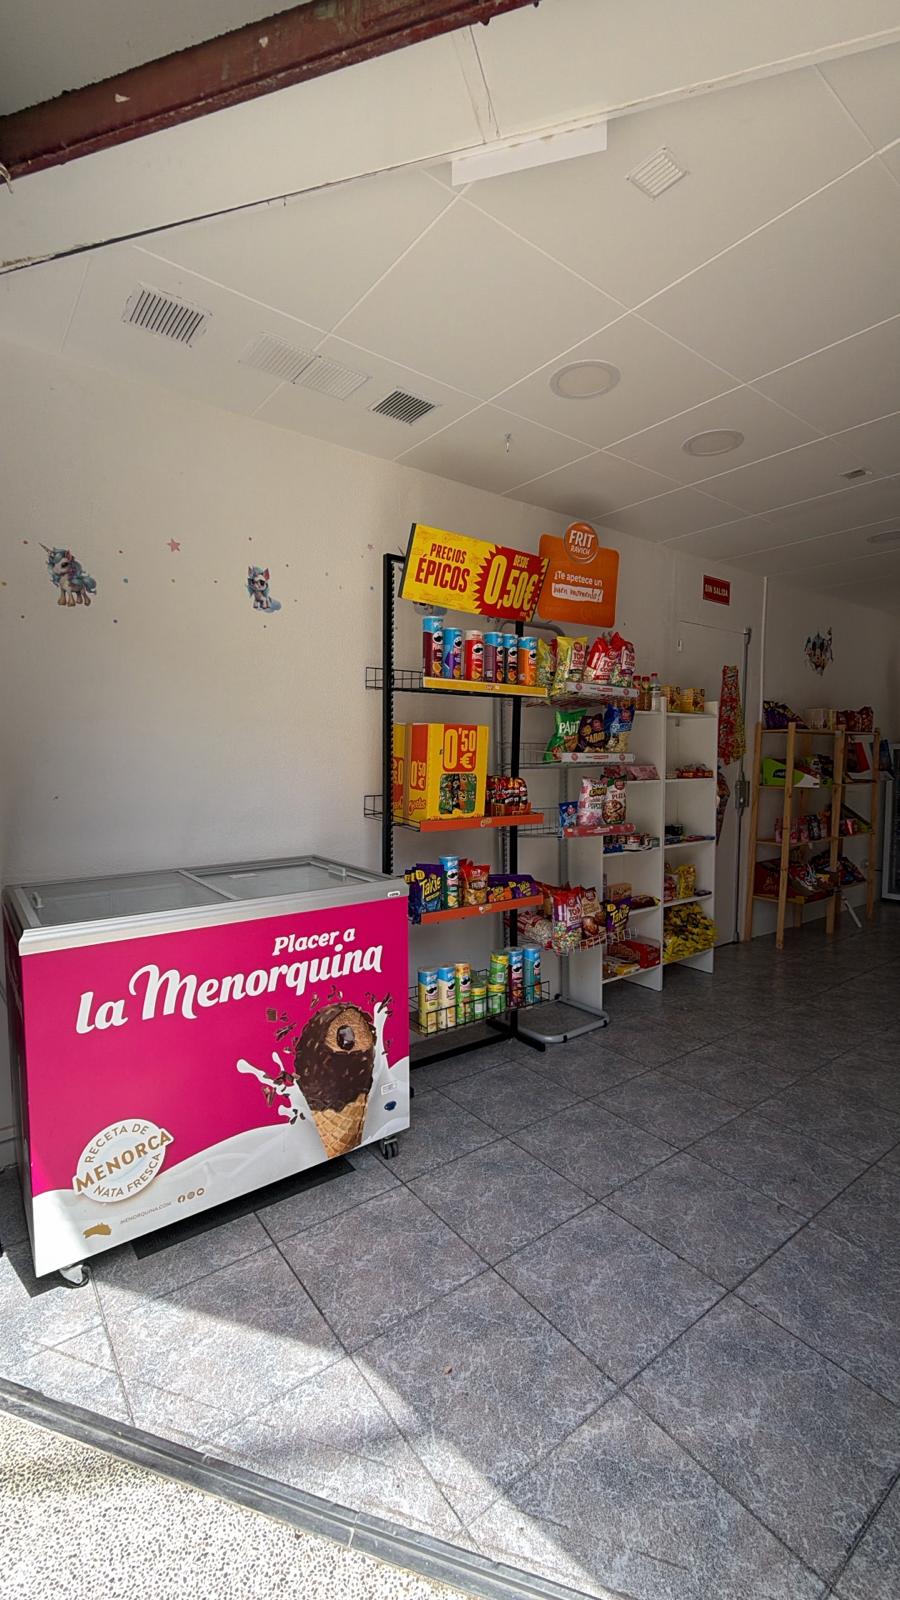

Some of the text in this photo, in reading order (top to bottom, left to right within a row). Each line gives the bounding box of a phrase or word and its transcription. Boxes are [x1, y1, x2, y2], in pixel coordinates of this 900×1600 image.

[429, 542, 467, 565] PRECIOS
[568, 529, 595, 548] FRIT
[414, 553, 471, 593] ÉPICOS
[513, 554, 530, 569] DESDE
[483, 554, 540, 611] 0,50€
[566, 573, 593, 585] apetece
[593, 578, 603, 587] un
[419, 876, 442, 899] Takis
[271, 927, 356, 958] Placer a
[75, 943, 384, 1035] la Menorquina
[84, 1123, 149, 1163] RECETA DE
[75, 1130, 172, 1193] MENORCA
[93, 1153, 161, 1198] NATA FRESCA
